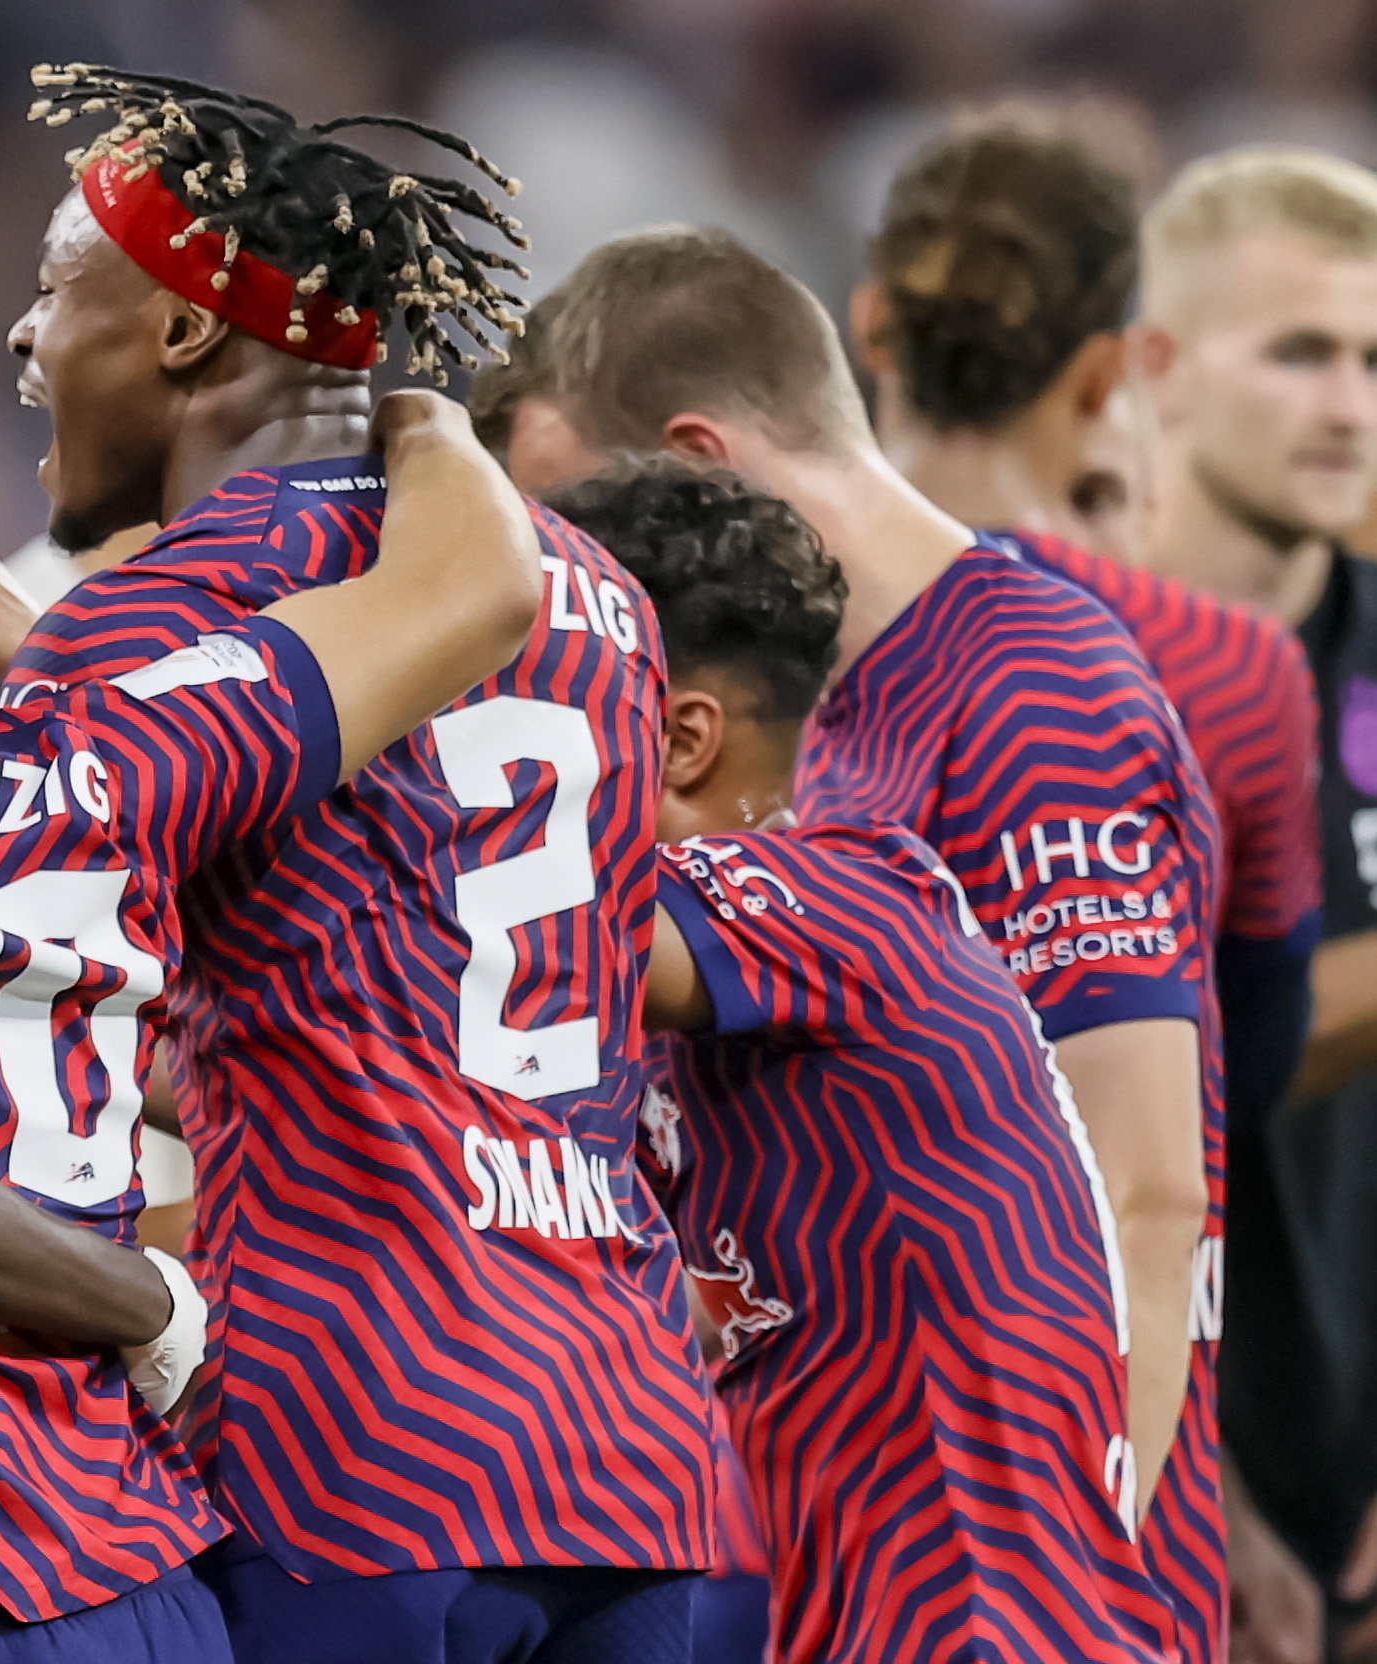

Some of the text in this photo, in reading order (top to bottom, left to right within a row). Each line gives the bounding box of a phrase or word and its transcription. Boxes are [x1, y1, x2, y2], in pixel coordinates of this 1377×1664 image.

[1000, 811, 1152, 892] IHG
[431, 695, 600, 1101] 2
[1003, 889, 1172, 941] HOTELS &
[1009, 926, 1178, 977] RESORTS
